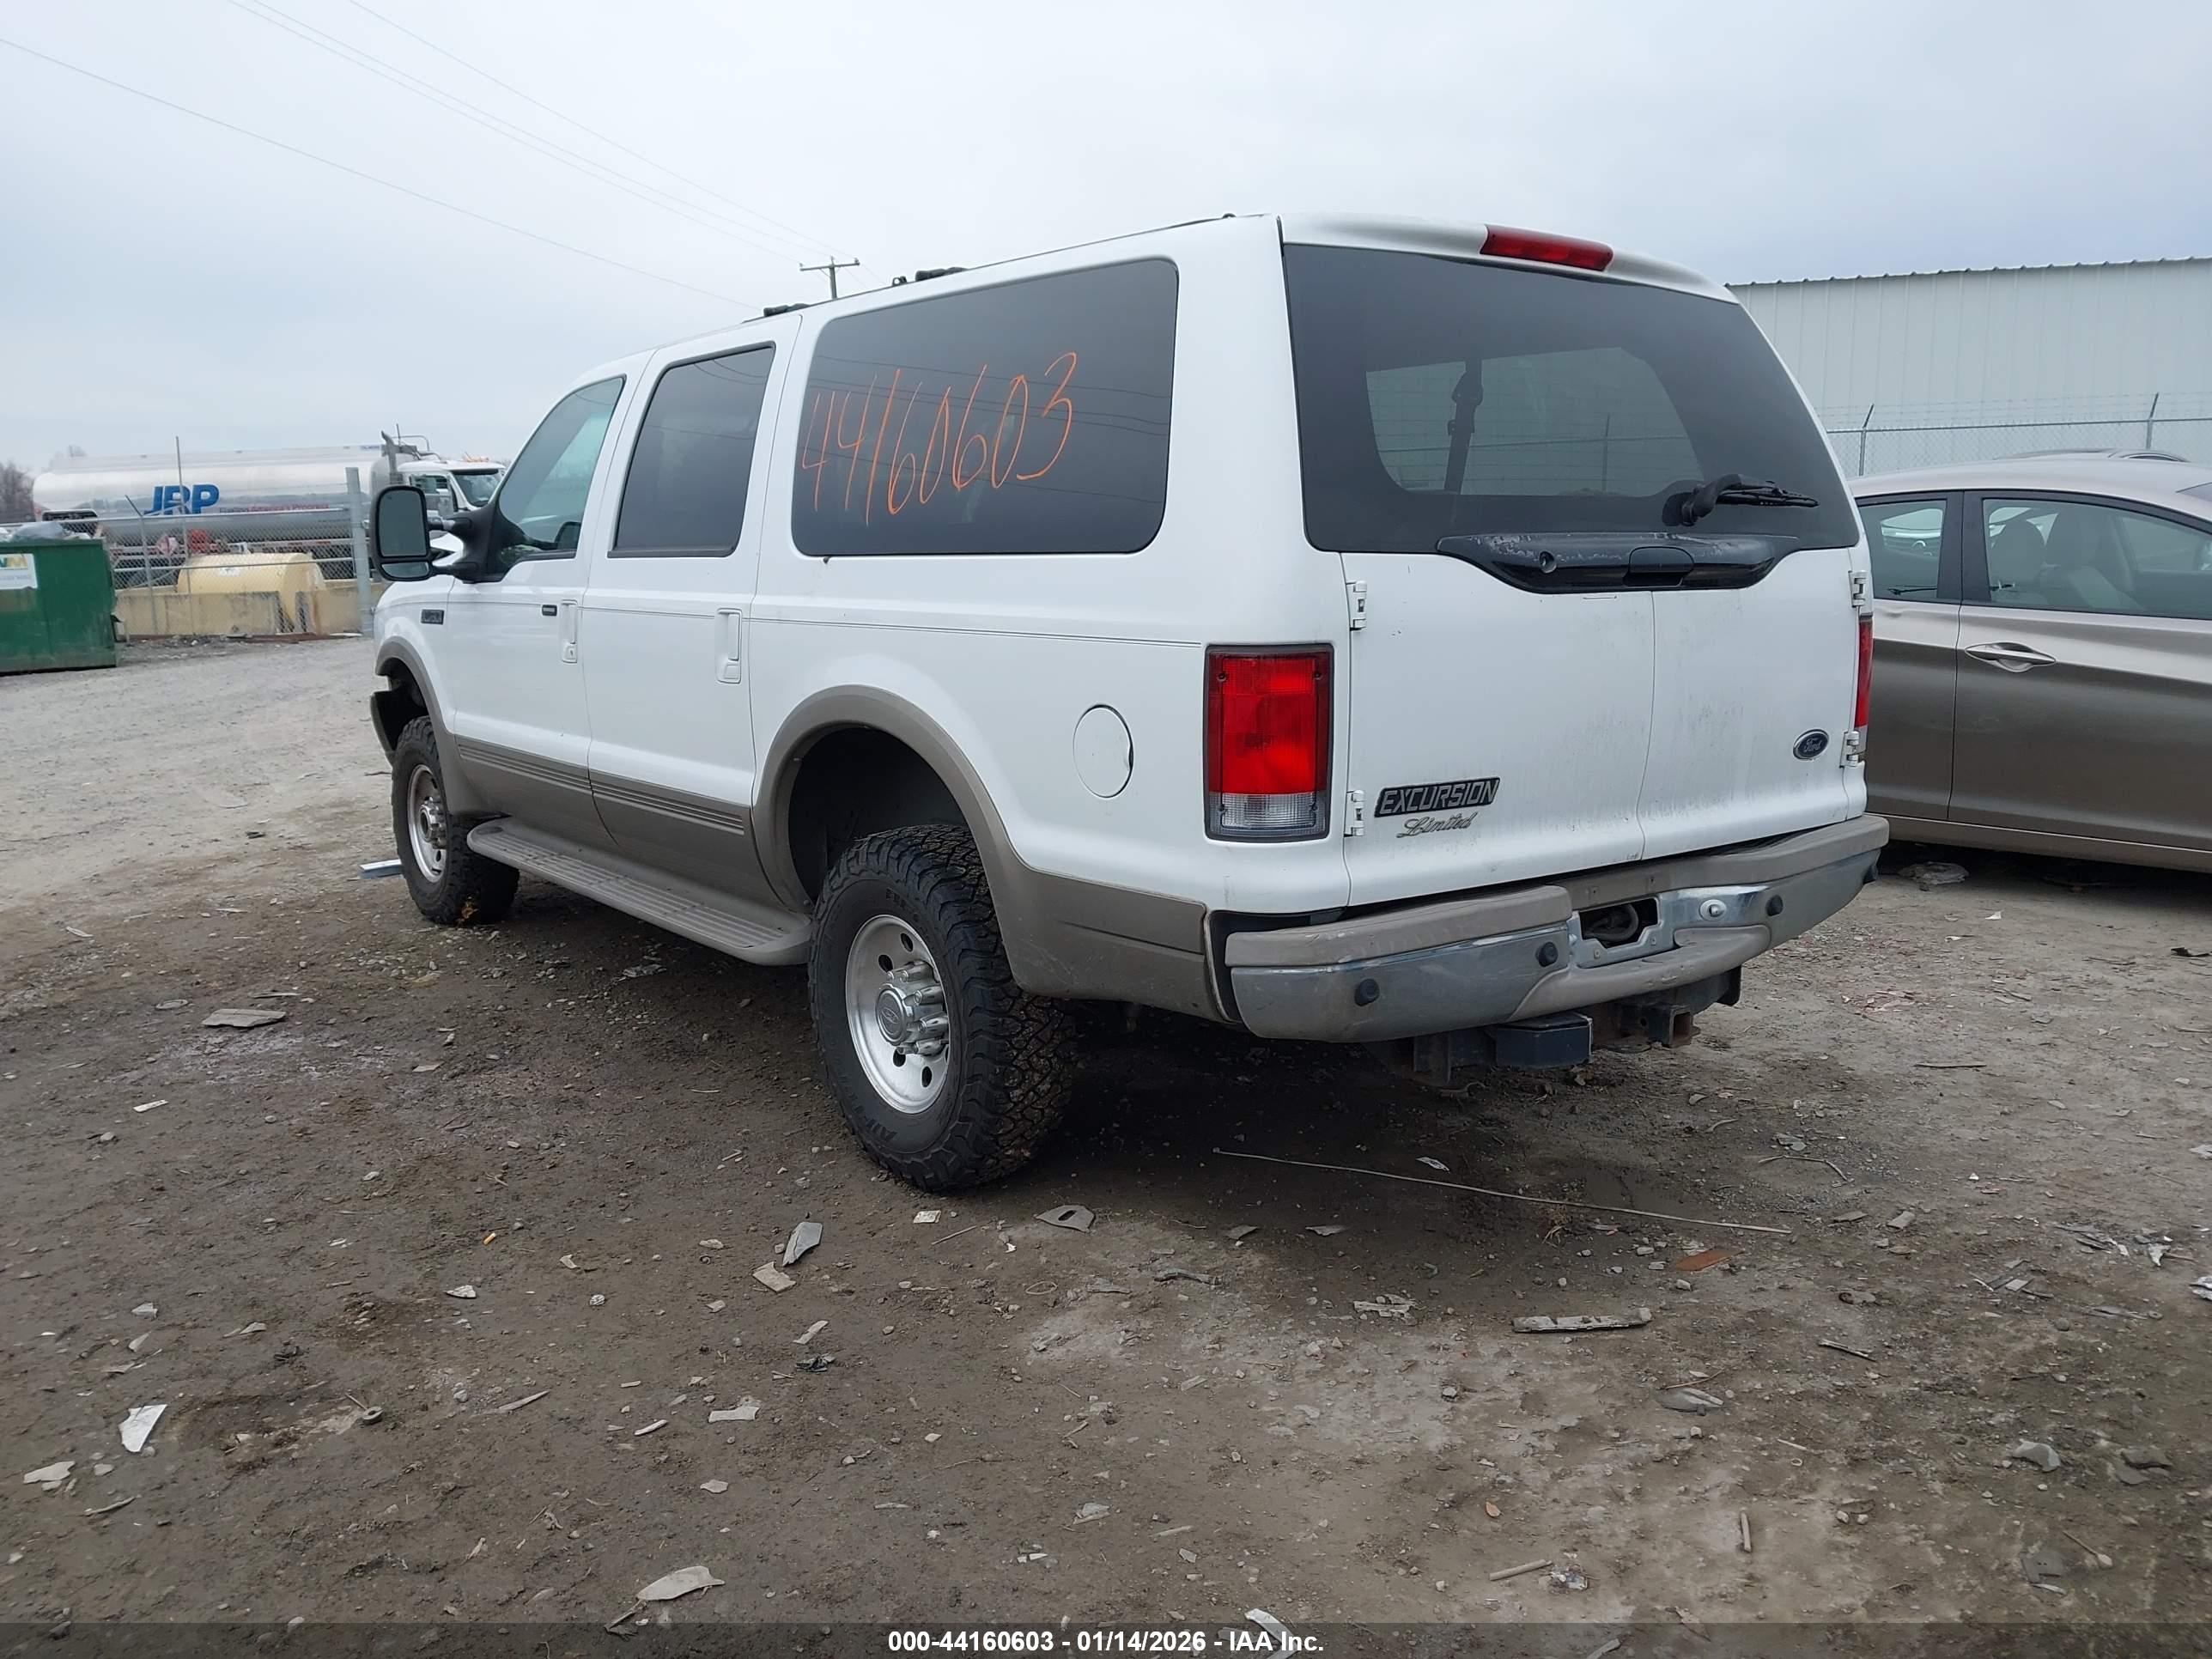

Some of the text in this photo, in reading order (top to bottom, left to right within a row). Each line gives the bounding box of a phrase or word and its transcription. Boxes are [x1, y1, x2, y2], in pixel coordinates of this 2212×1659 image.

[801, 351, 1077, 526] 44160603
[143, 483, 220, 514] JRP
[1379, 780, 1499, 815] EXCURSION
[1396, 811, 1479, 838] Limited
